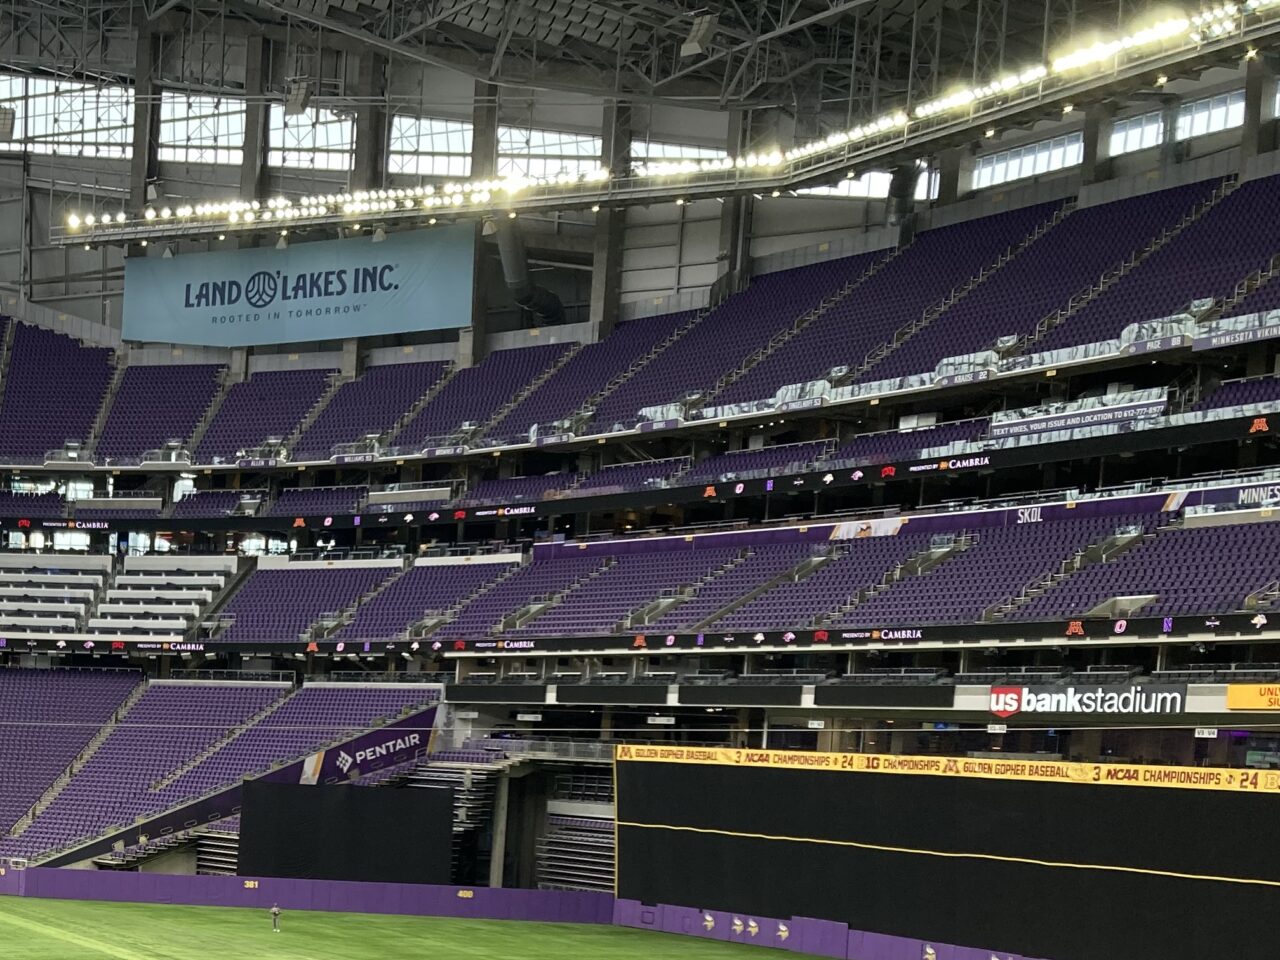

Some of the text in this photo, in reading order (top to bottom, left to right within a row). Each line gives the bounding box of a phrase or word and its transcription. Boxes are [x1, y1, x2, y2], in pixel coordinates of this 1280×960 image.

[184, 280, 242, 308] LAND
[353, 264, 399, 294] INC.
[212, 313, 261, 324] ROOTED
[268, 311, 280, 320] IN
[978, 370, 987, 379] 22
[1066, 416, 1081, 425] AND
[1081, 413, 1113, 424] LOCATION
[1114, 411, 1123, 419] TO
[948, 457, 989, 469] CAMBRIA
[1017, 507, 1043, 524] SKOL
[75, 520, 109, 529] CAMBRIA
[881, 629, 922, 640] CAMBRIA
[170, 642, 204, 651] CAMBRIA
[504, 640, 535, 648] CAMBRIA
[355, 733, 420, 764] PENTAIR
[635, 748, 659, 758] GOLDEN
[660, 749, 684, 759] GOPHER
[685, 750, 717, 761] BASEBALL
[735, 751, 741, 763] 3
[744, 753, 770, 764] NCAA
[773, 754, 830, 767] CHAMPIONSHIPS
[841, 755, 853, 769] 24
[883, 760, 940, 771] CHAMPIONSHIPS
[963, 762, 993, 773] GOLDEN
[995, 763, 1026, 776] GOPHER
[1028, 764, 1070, 778] BASEBALL
[1093, 766, 1101, 782] 3
[1106, 768, 1139, 781] NCAA
[1143, 769, 1221, 785] CHAMPIONSHIPS
[1239, 772, 1259, 789] 24
[244, 880, 259, 889] 381
[457, 890, 474, 898] 400
